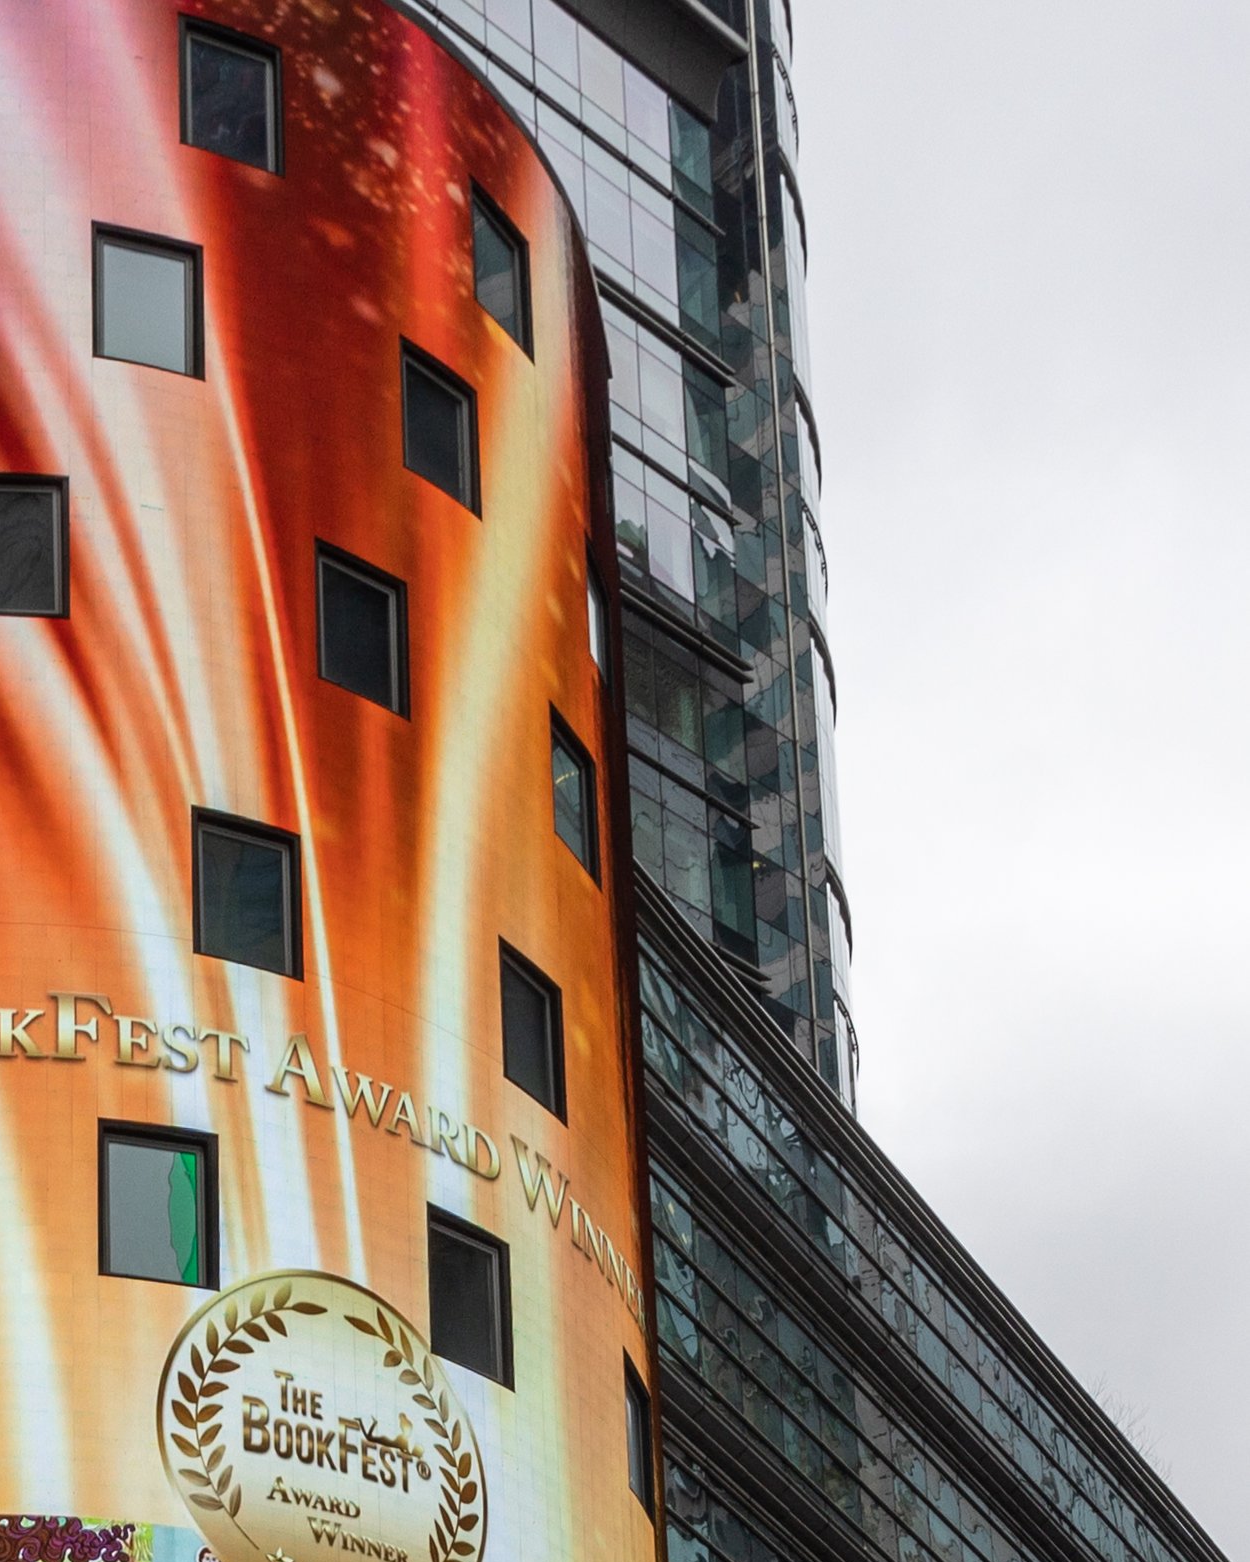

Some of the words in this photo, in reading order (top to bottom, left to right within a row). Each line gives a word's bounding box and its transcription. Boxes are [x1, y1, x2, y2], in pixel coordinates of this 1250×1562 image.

[264, 1033, 502, 1181] AWARD
[273, 1369, 323, 1420] THE
[266, 1475, 361, 1519] AWARD
